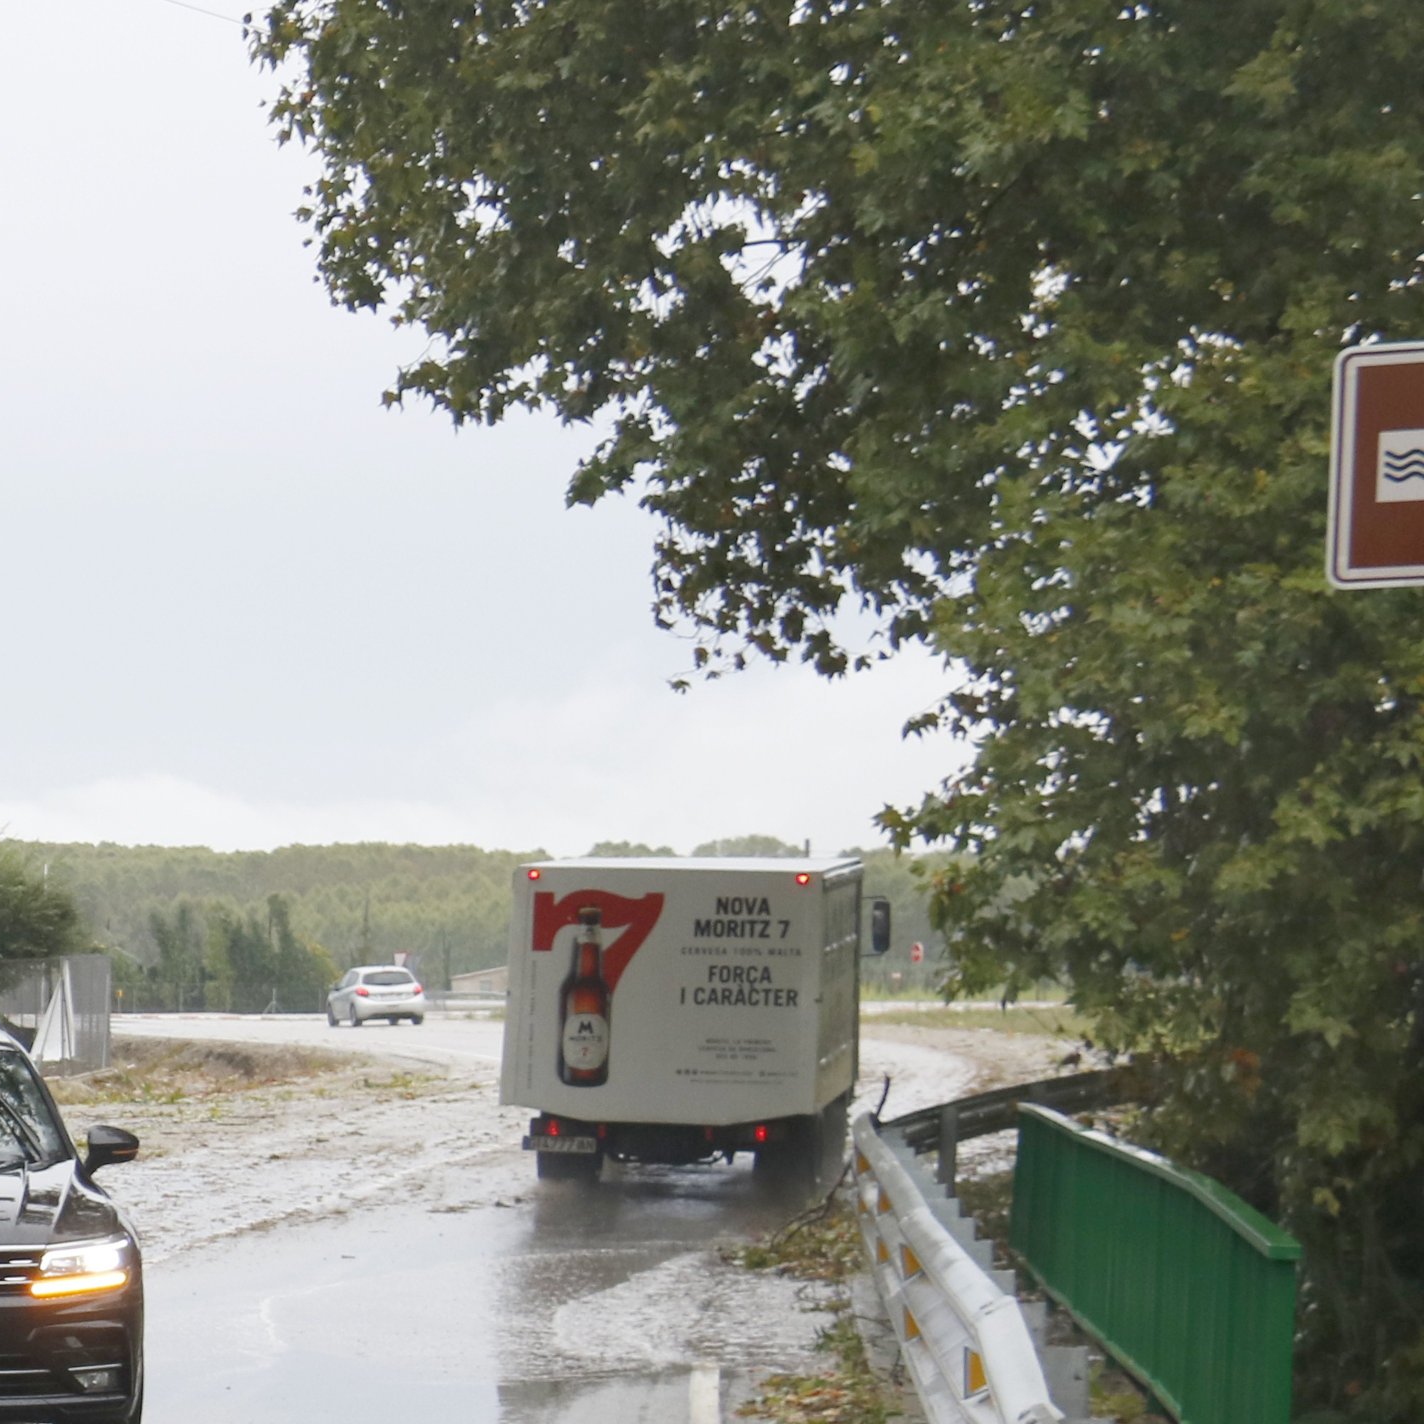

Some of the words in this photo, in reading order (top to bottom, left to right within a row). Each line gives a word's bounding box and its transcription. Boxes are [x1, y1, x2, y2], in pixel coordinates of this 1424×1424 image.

[715, 896, 771, 916] NOVA
[693, 919, 771, 938] MORITZ
[777, 919, 791, 939] 7
[532, 889, 665, 997] 7
[707, 965, 773, 987] FORÇA
[679, 986, 687, 1006] I
[692, 984, 799, 1007] CARÀCTER
